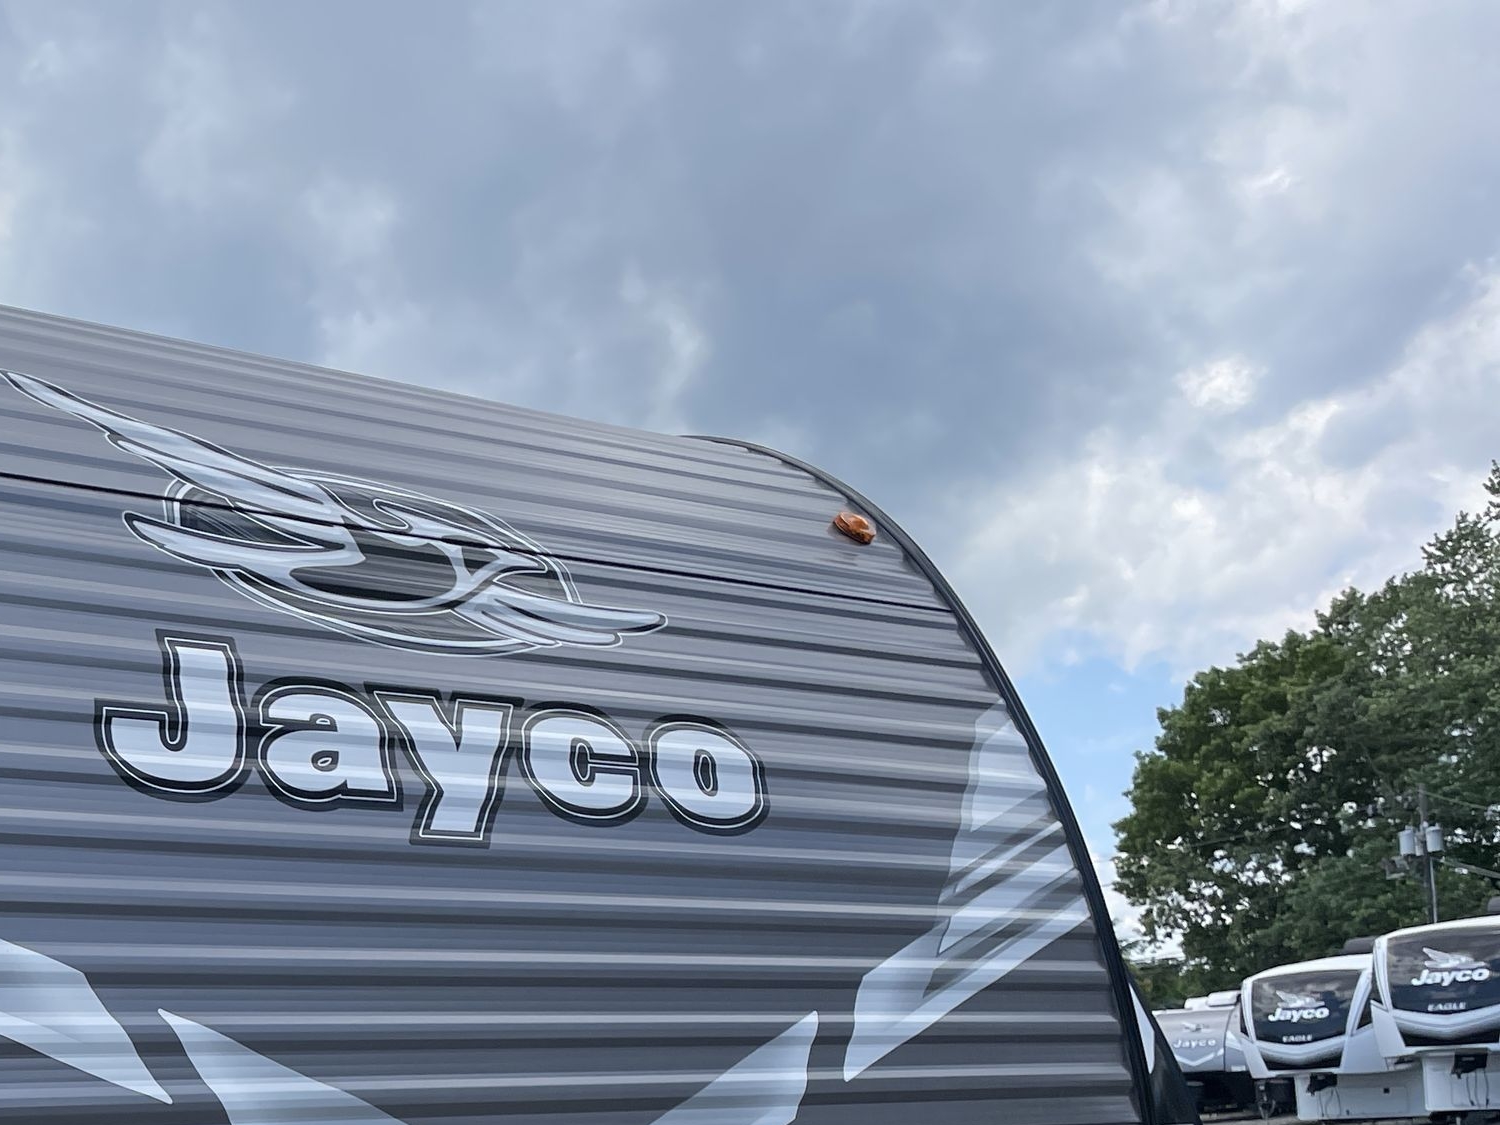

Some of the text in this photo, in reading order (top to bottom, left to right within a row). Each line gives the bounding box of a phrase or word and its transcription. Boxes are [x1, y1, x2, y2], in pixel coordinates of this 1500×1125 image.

[95, 628, 769, 849] Jayco
[1411, 967, 1490, 987] Jayco
[1427, 1001, 1467, 1012] EAGLE
[1267, 1006, 1330, 1023] Jayco
[1173, 1039, 1217, 1049] Jayco
[1282, 1033, 1313, 1043] EAGLE
